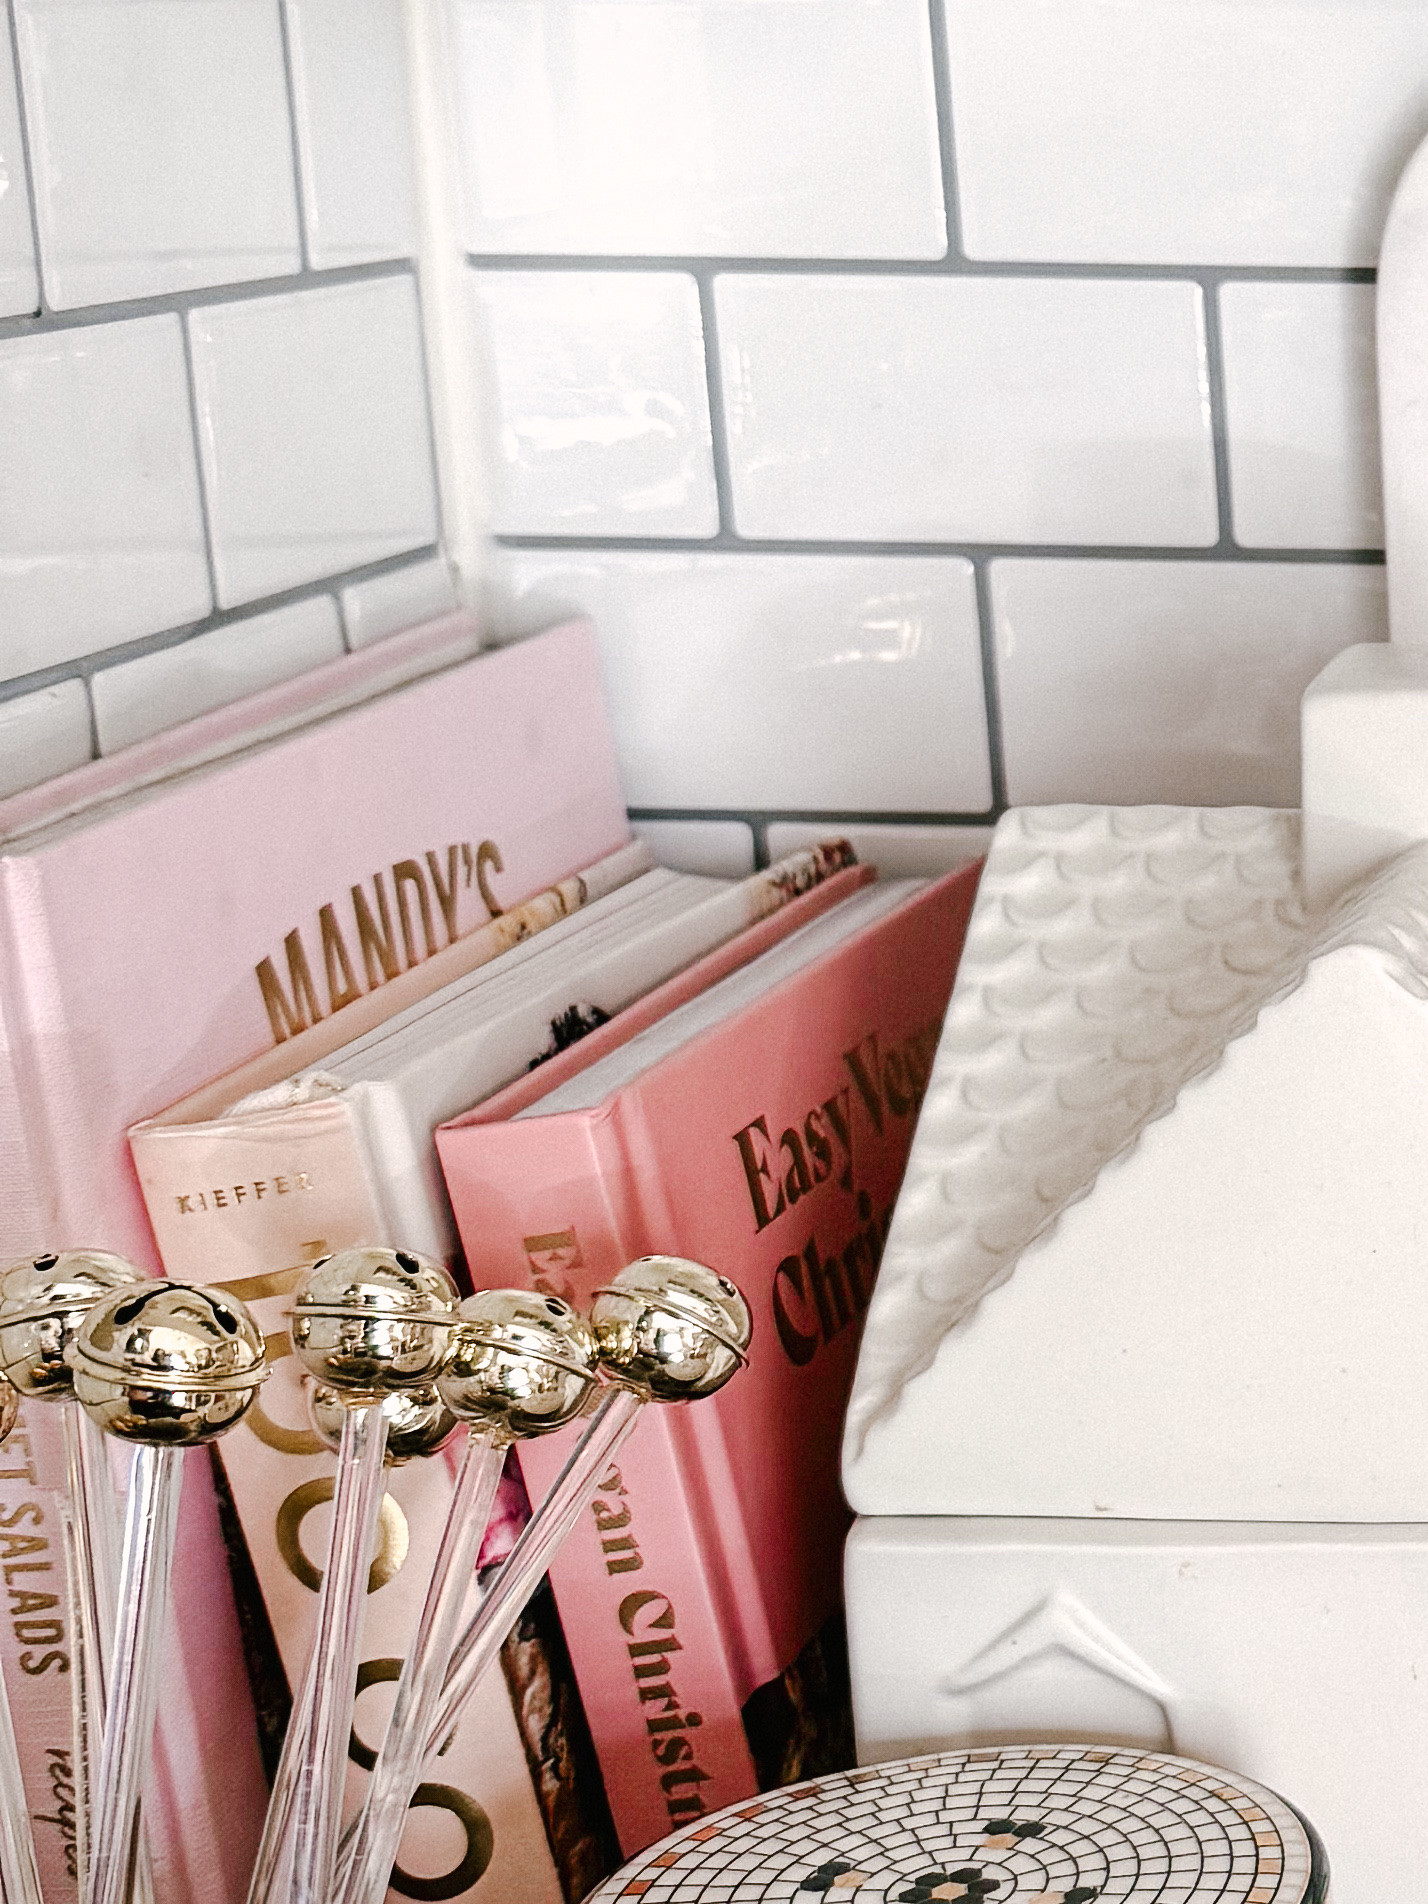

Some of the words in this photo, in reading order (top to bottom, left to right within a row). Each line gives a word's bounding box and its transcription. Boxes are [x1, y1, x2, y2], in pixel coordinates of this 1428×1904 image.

[254, 838, 513, 1045] MANDY'S
[175, 1170, 315, 1215] KIEFFER
[732, 1086, 856, 1235] Easy
[0, 1499, 71, 1678] SALADS
